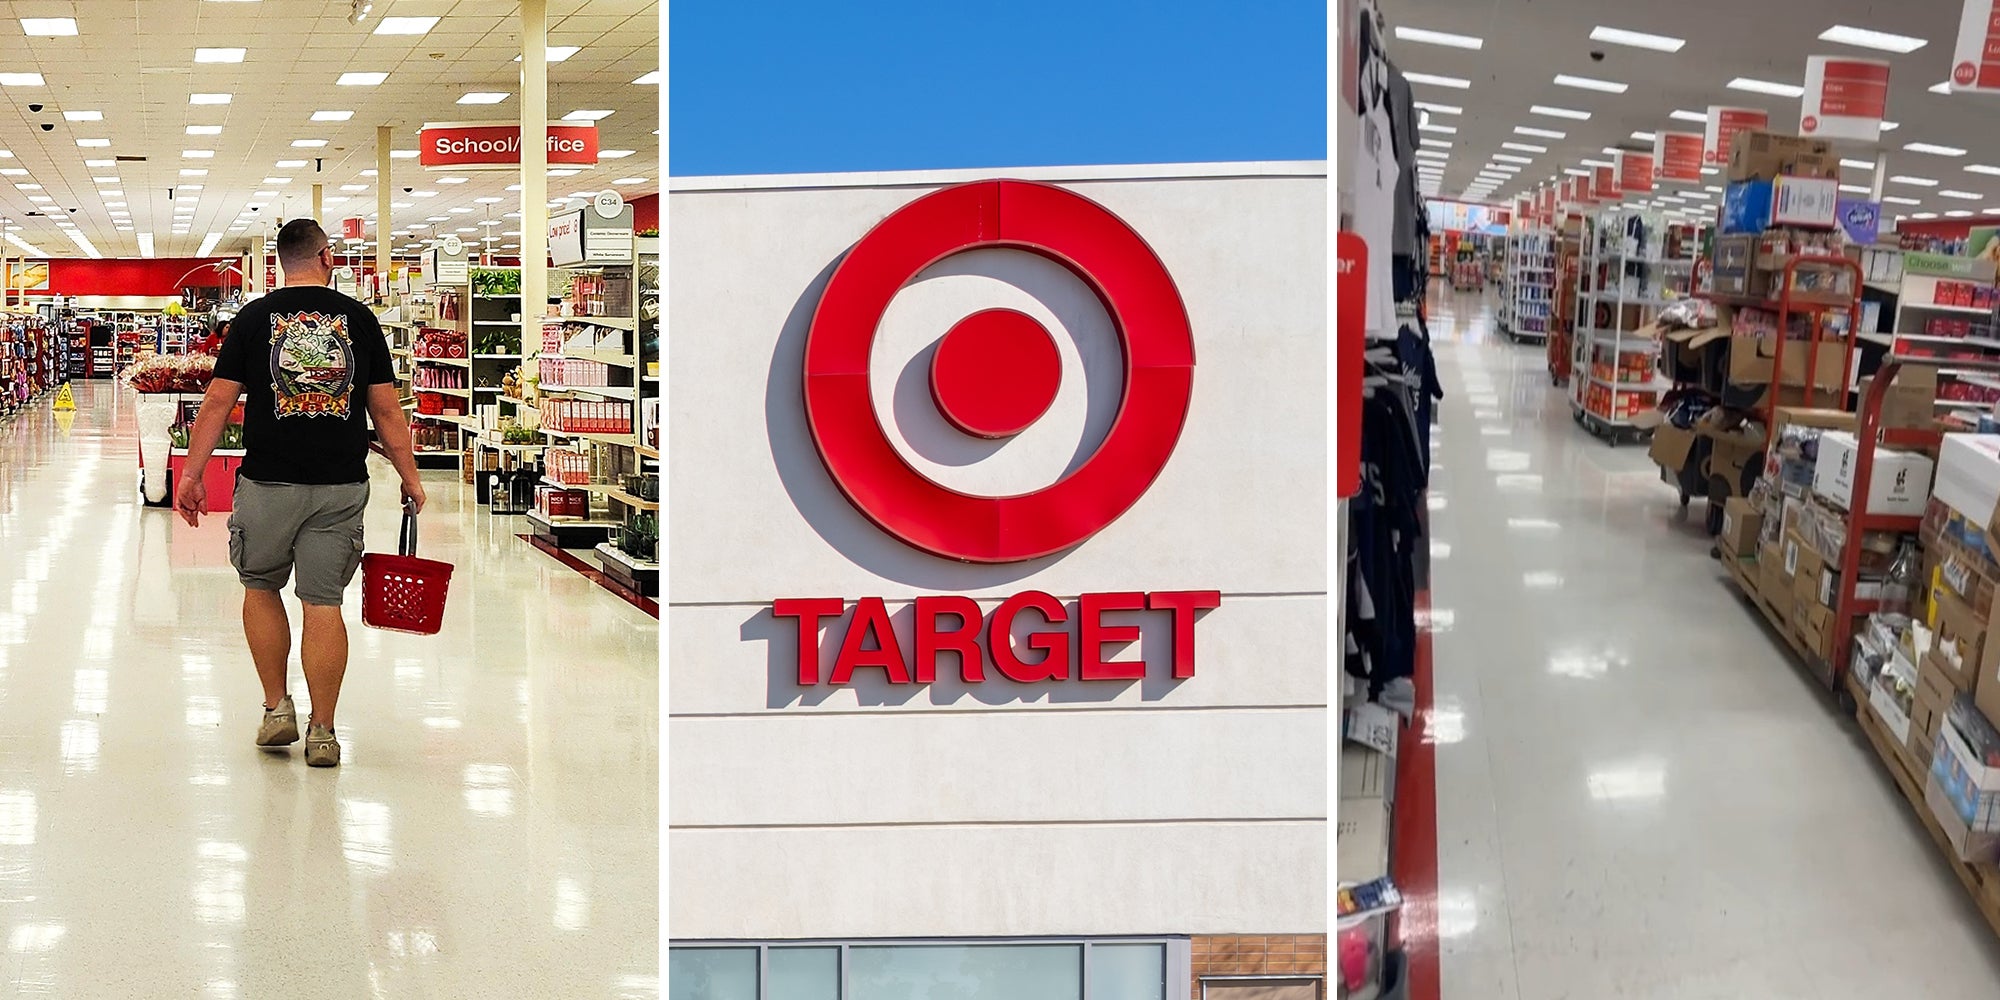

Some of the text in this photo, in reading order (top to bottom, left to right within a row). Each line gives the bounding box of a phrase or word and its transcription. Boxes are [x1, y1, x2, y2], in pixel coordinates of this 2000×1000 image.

[435, 136, 585, 154] School/fice
[600, 198, 617, 206] C34
[773, 590, 1221, 685] TARGET
